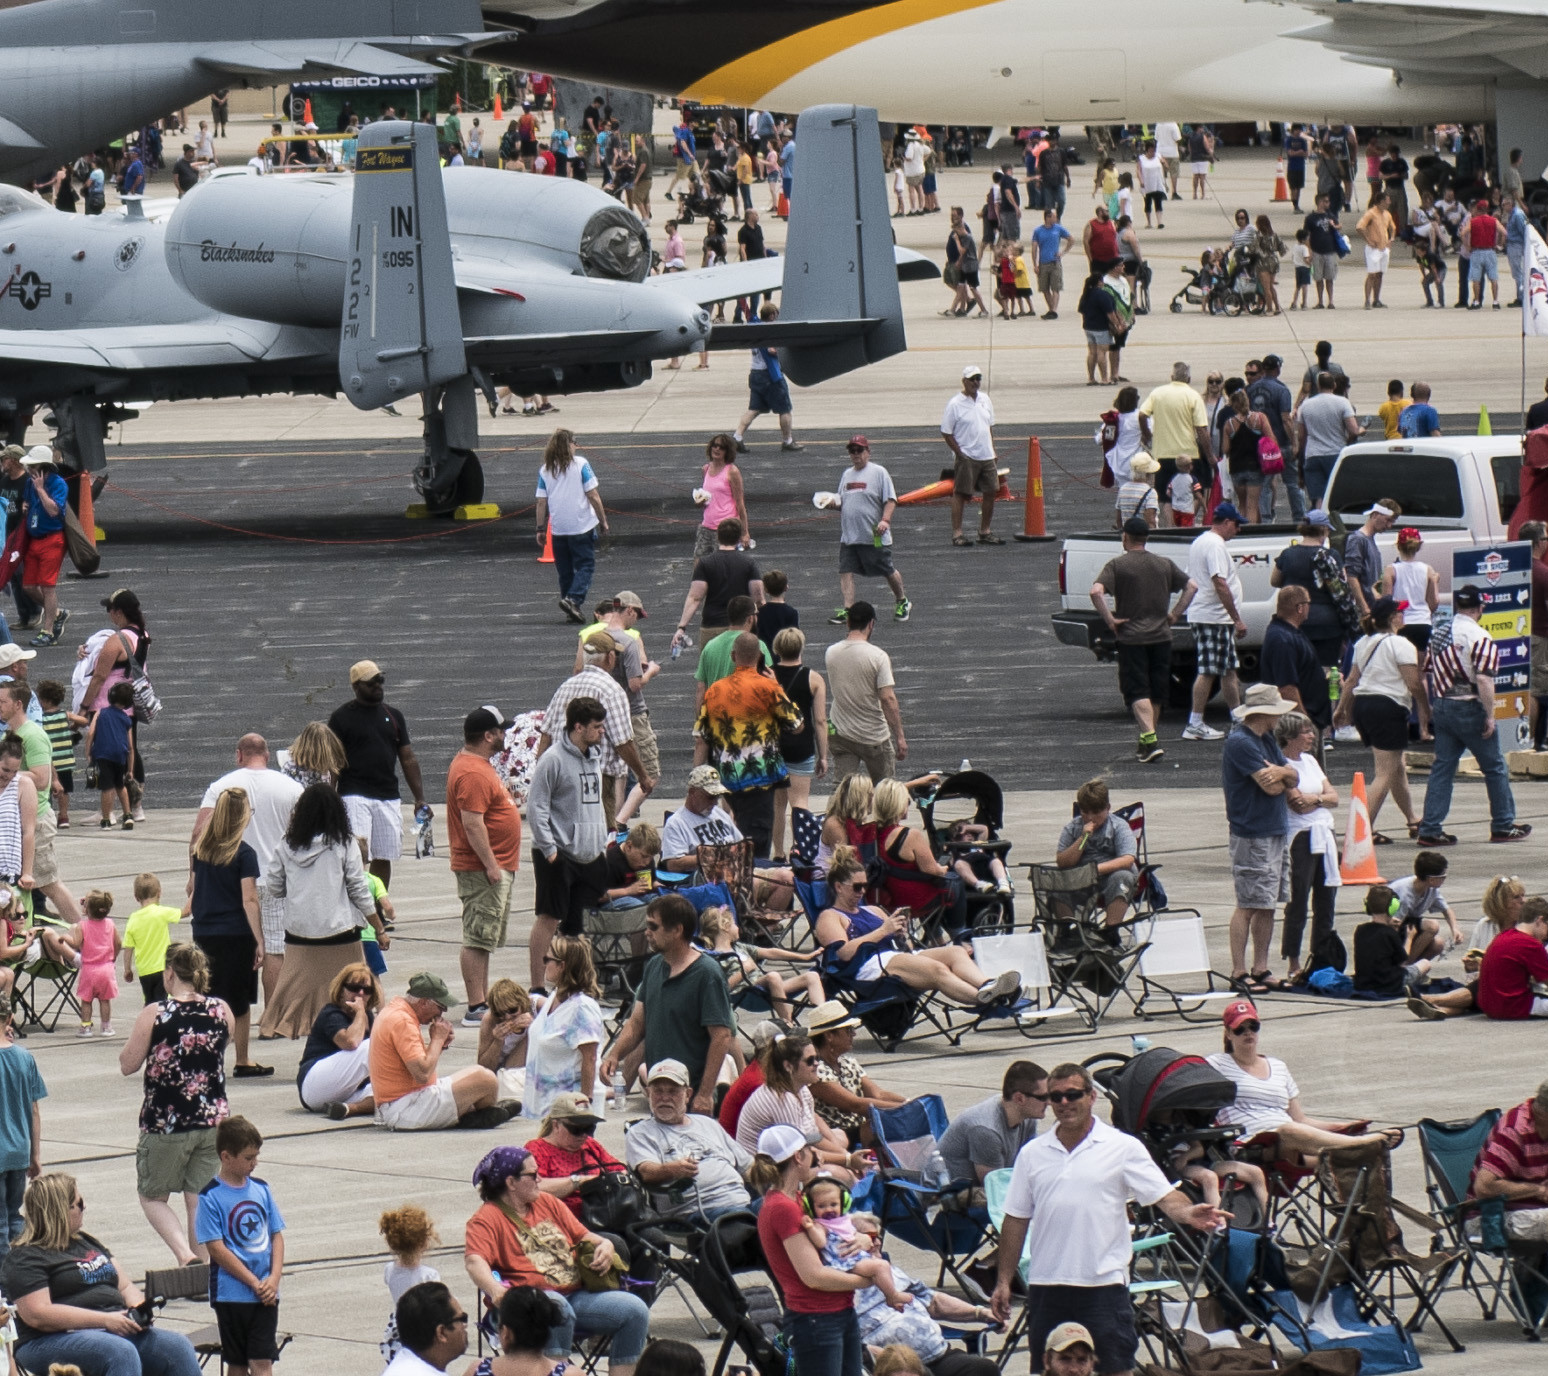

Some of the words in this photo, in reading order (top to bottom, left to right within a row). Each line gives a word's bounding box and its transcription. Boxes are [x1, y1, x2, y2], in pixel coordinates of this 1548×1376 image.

[332, 77, 380, 88] GEICO
[362, 152, 375, 166] Fort
[377, 152, 406, 166] Wayne
[390, 206, 413, 238] IN
[201, 239, 275, 263] Blacksnakes
[390, 251, 414, 268] 095
[1491, 621, 1513, 632] FOUND
[693, 819, 731, 844] FEAR
